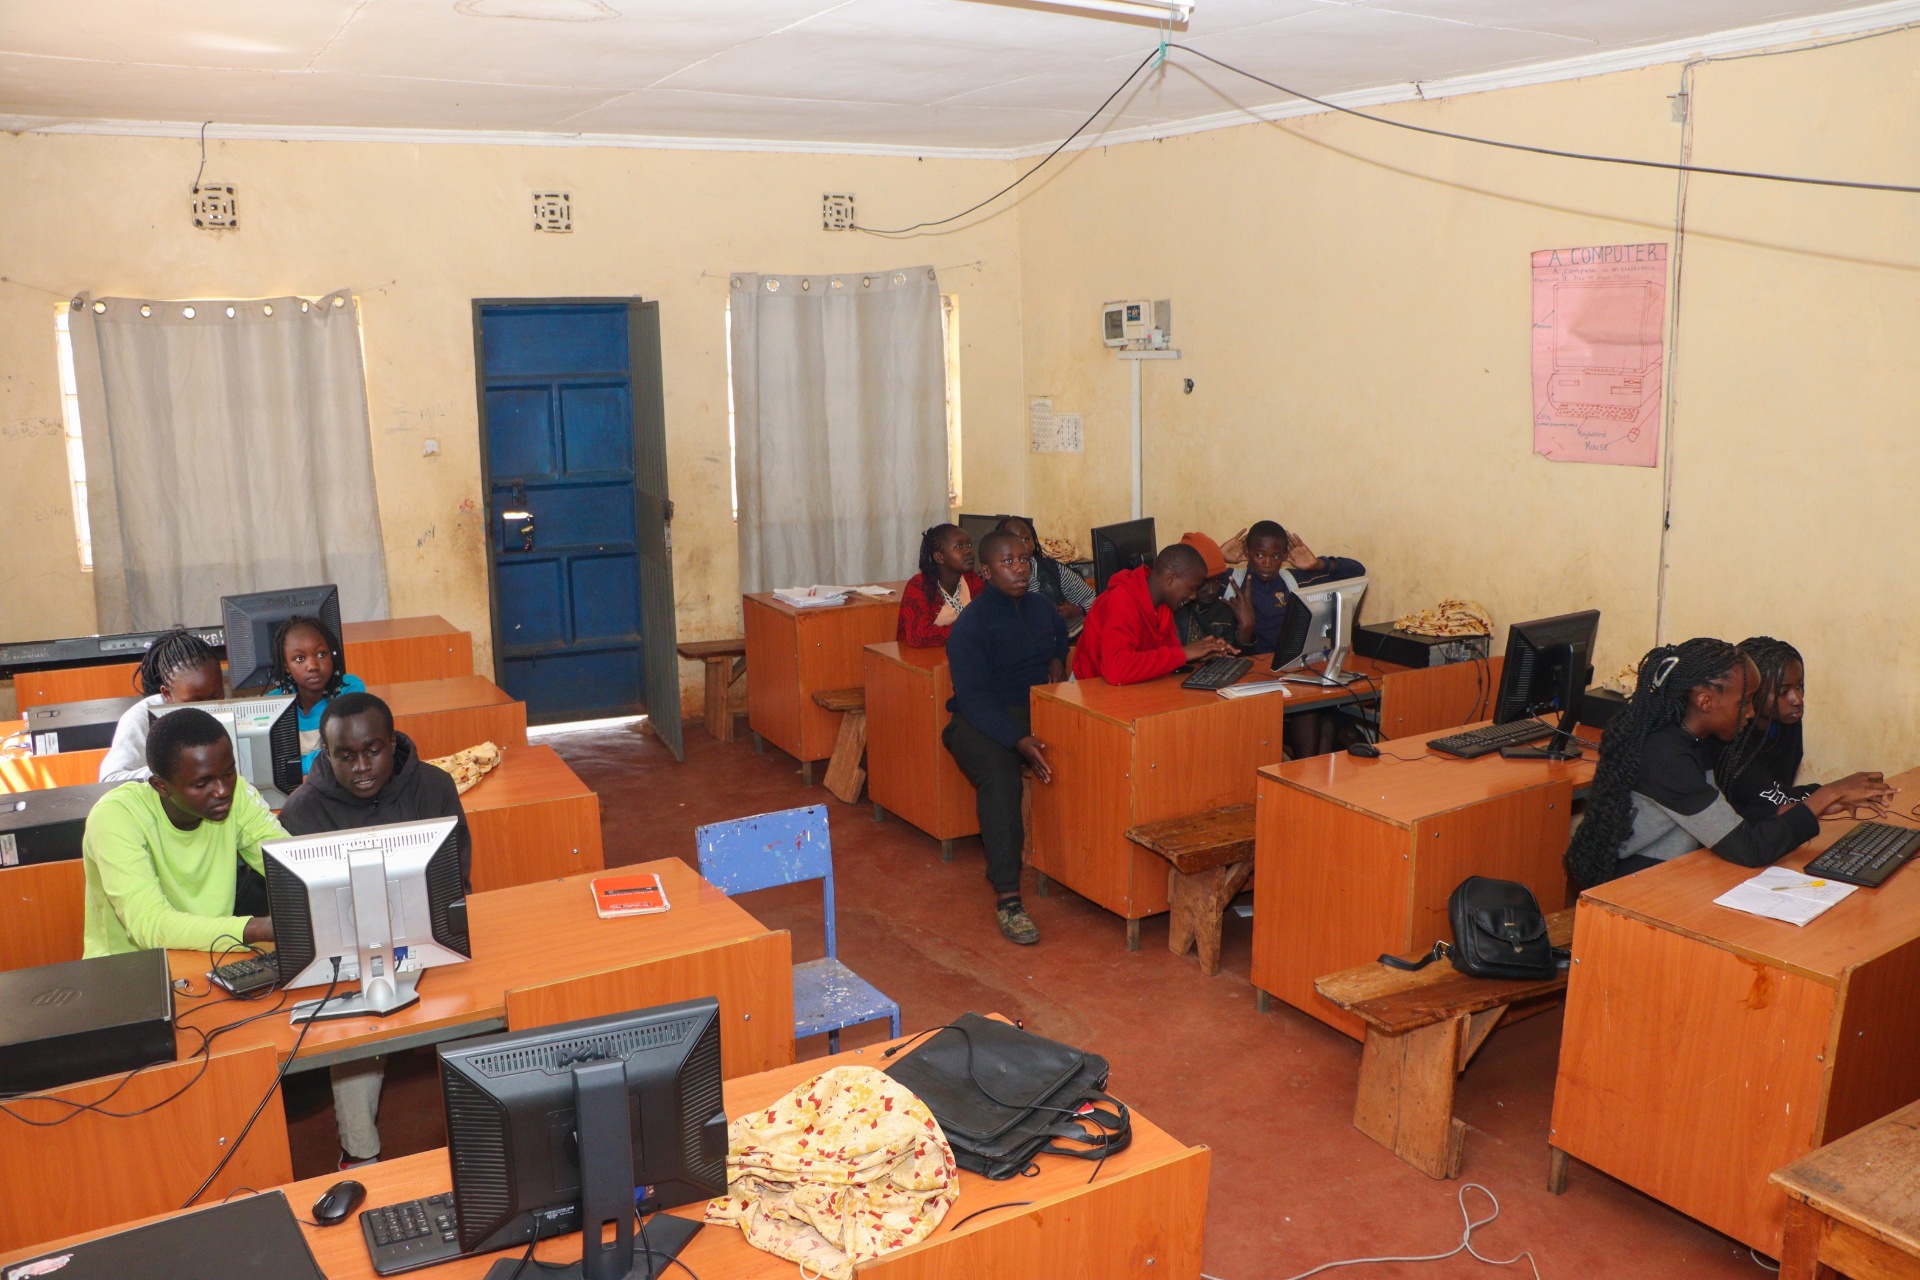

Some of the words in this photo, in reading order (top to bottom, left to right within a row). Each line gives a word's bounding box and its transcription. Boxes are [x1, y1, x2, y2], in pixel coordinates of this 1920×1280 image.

[1549, 249, 1562, 267] A
[1571, 243, 1659, 265] COMPUTER
[1585, 440, 1608, 452] Mouse
